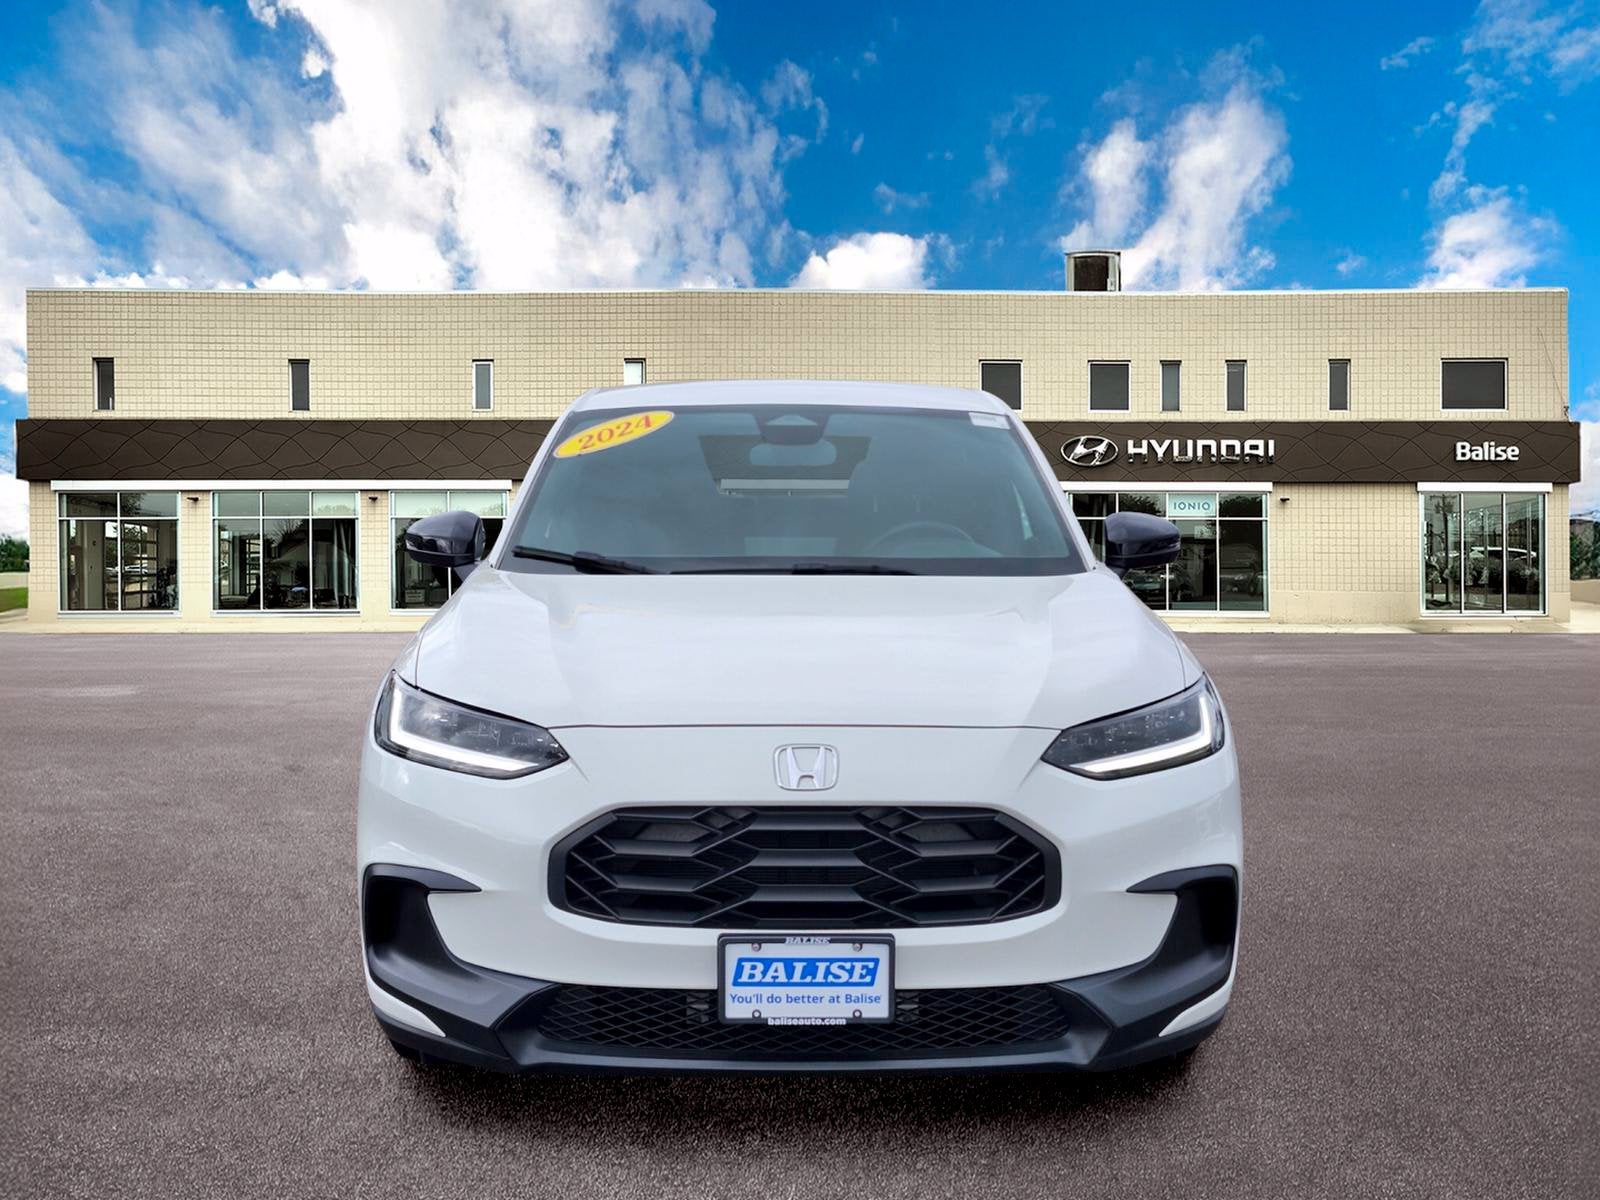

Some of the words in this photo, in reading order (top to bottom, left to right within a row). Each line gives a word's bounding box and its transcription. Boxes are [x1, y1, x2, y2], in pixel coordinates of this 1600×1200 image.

[578, 415, 653, 450] 2024
[1127, 439, 1275, 463] HYUNDAI
[1455, 441, 1520, 461] Balise
[785, 937, 830, 945] BALISE
[737, 961, 874, 983] BALISE
[730, 993, 763, 1004] You'll
[766, 993, 782, 1004] do
[786, 993, 824, 1004] better
[828, 995, 841, 1004] at
[845, 993, 881, 1004] Balise
[768, 1017, 846, 1026] baliseauto.com
